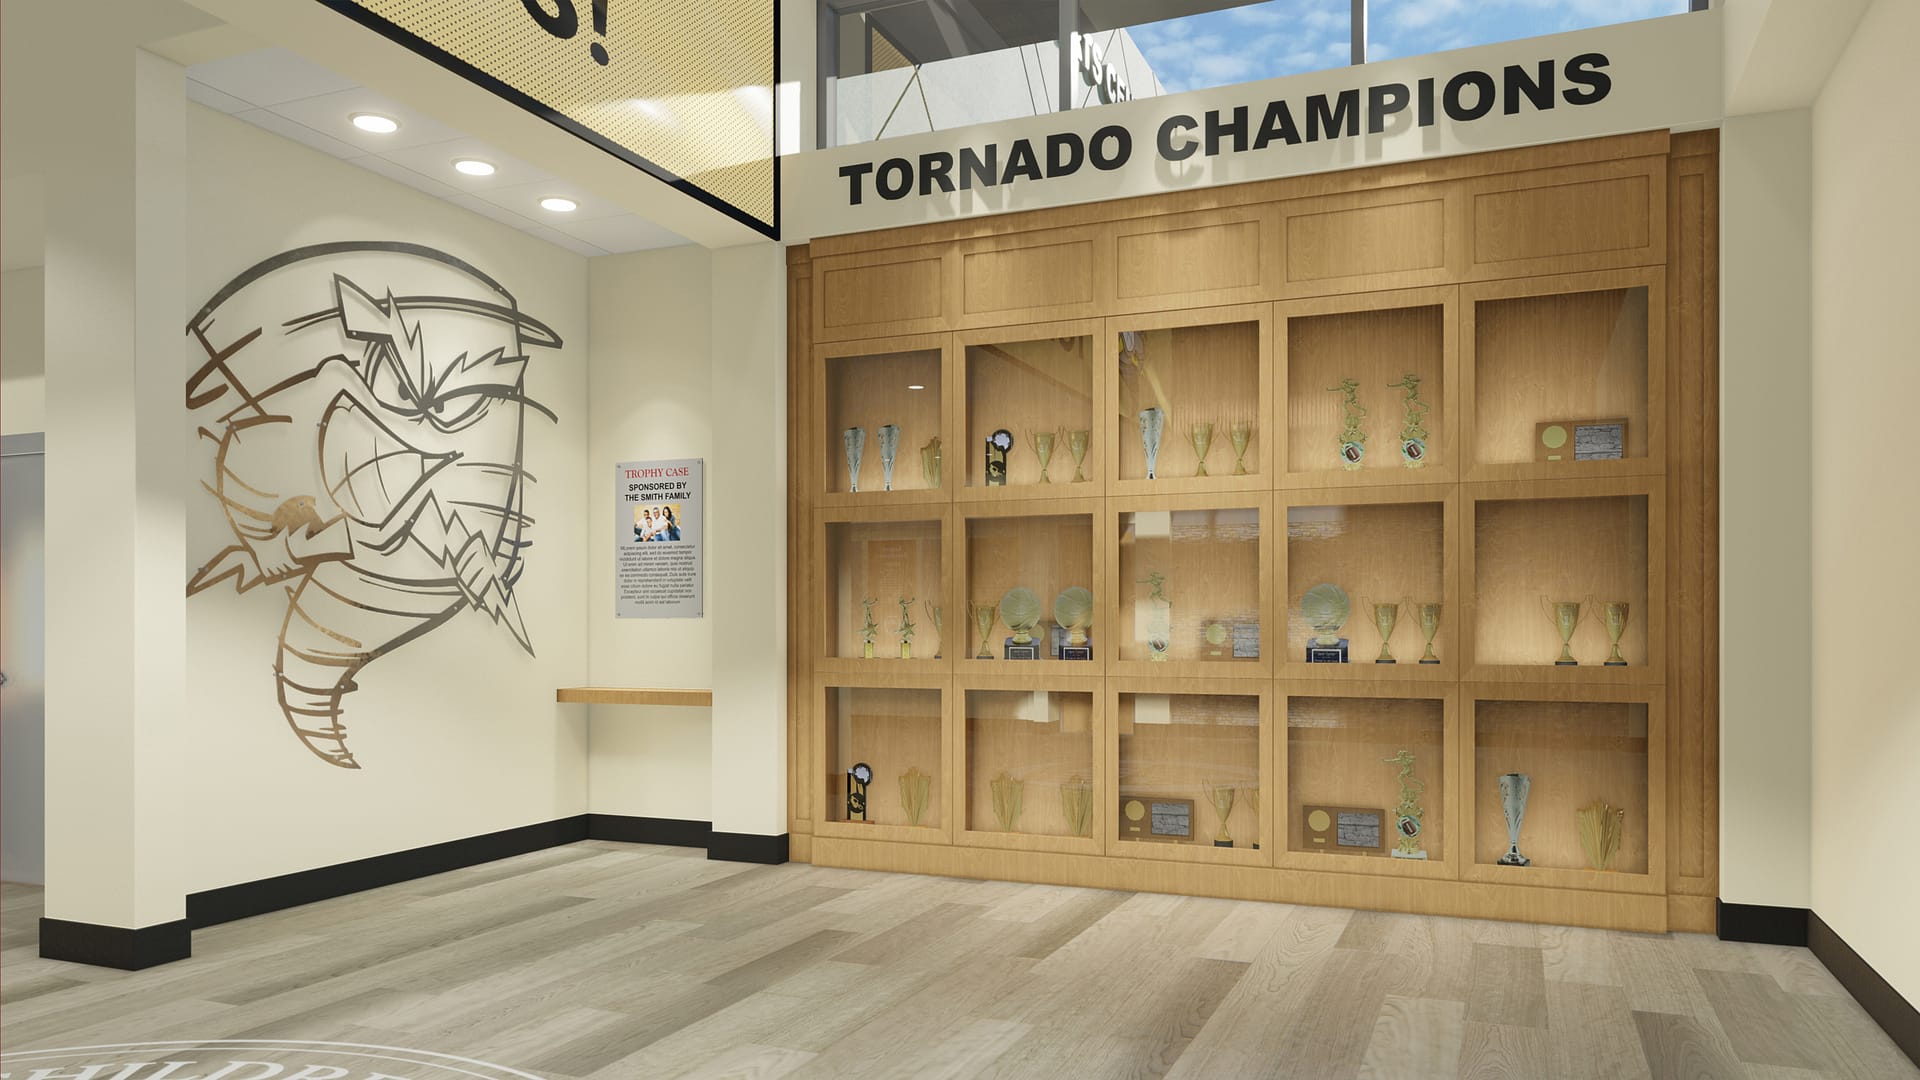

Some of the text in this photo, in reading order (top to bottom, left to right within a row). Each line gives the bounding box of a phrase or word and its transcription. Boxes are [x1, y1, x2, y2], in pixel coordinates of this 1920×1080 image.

[838, 52, 1613, 206] TORNADO CHAMPIONS
[624, 467, 689, 479] TROPHY CASE
[628, 481, 687, 491] SPONSORED BY
[640, 493, 663, 501] SMITH
[664, 491, 691, 500] FAMILY
